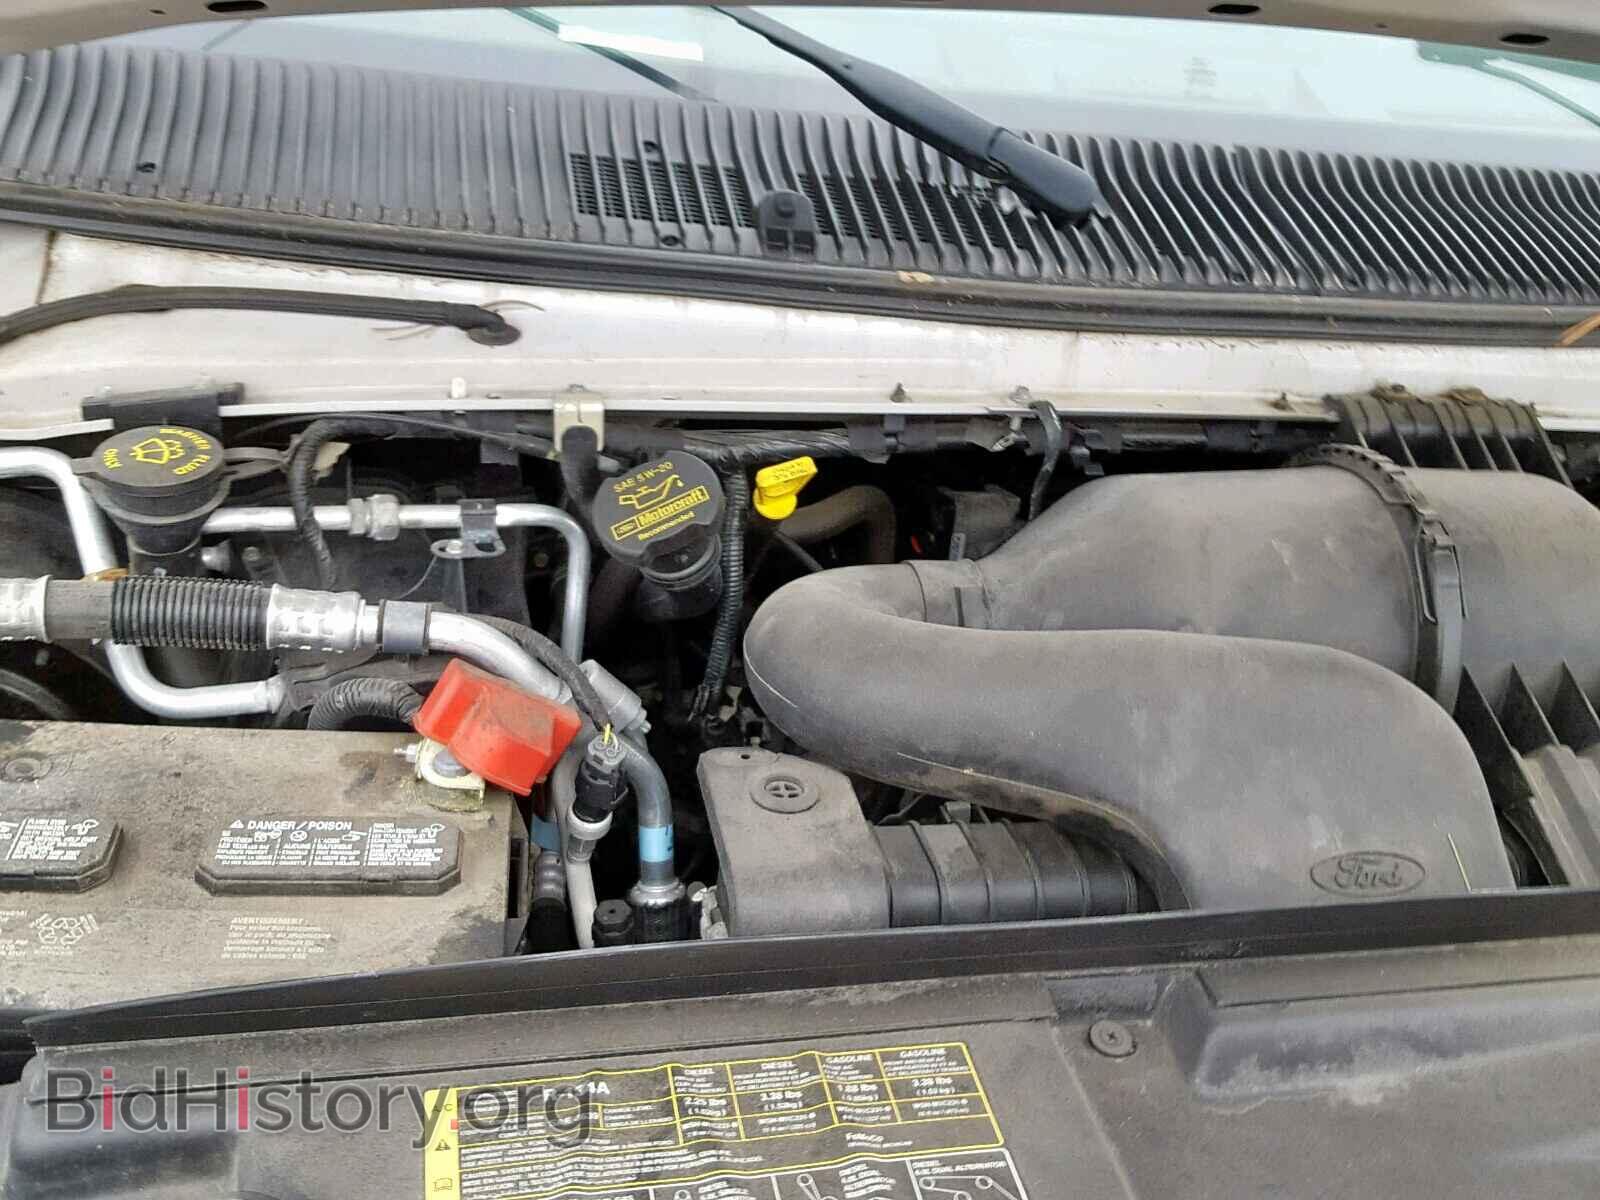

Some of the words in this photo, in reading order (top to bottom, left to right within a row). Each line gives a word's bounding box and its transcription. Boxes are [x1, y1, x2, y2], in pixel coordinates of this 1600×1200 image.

[613, 478, 636, 493] SAE
[636, 461, 673, 482] 5W-20
[638, 488, 704, 527] Motorcraft
[1334, 856, 1402, 890] Ford
